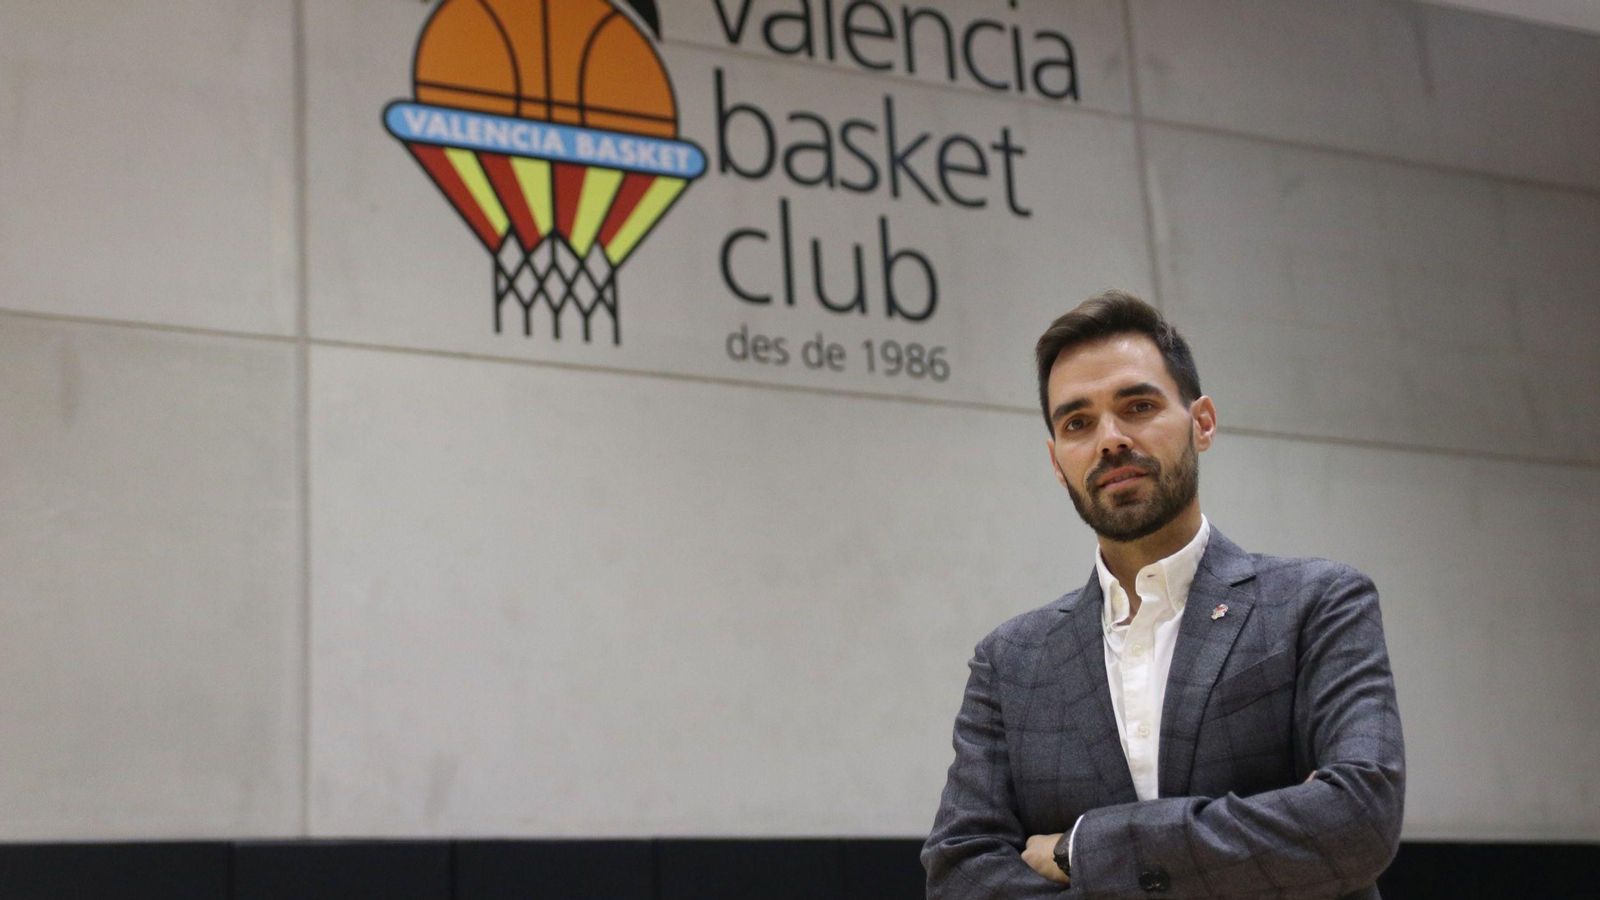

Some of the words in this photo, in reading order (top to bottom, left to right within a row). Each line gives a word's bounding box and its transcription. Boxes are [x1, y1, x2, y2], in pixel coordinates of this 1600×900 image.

[713, 0, 1079, 102] valencia
[402, 109, 565, 154] VALENCIA
[576, 133, 690, 171] BASKET
[714, 68, 1032, 218] basket
[720, 198, 938, 322] club
[726, 325, 789, 366] des
[802, 333, 845, 373] de
[862, 338, 950, 382] 1986
